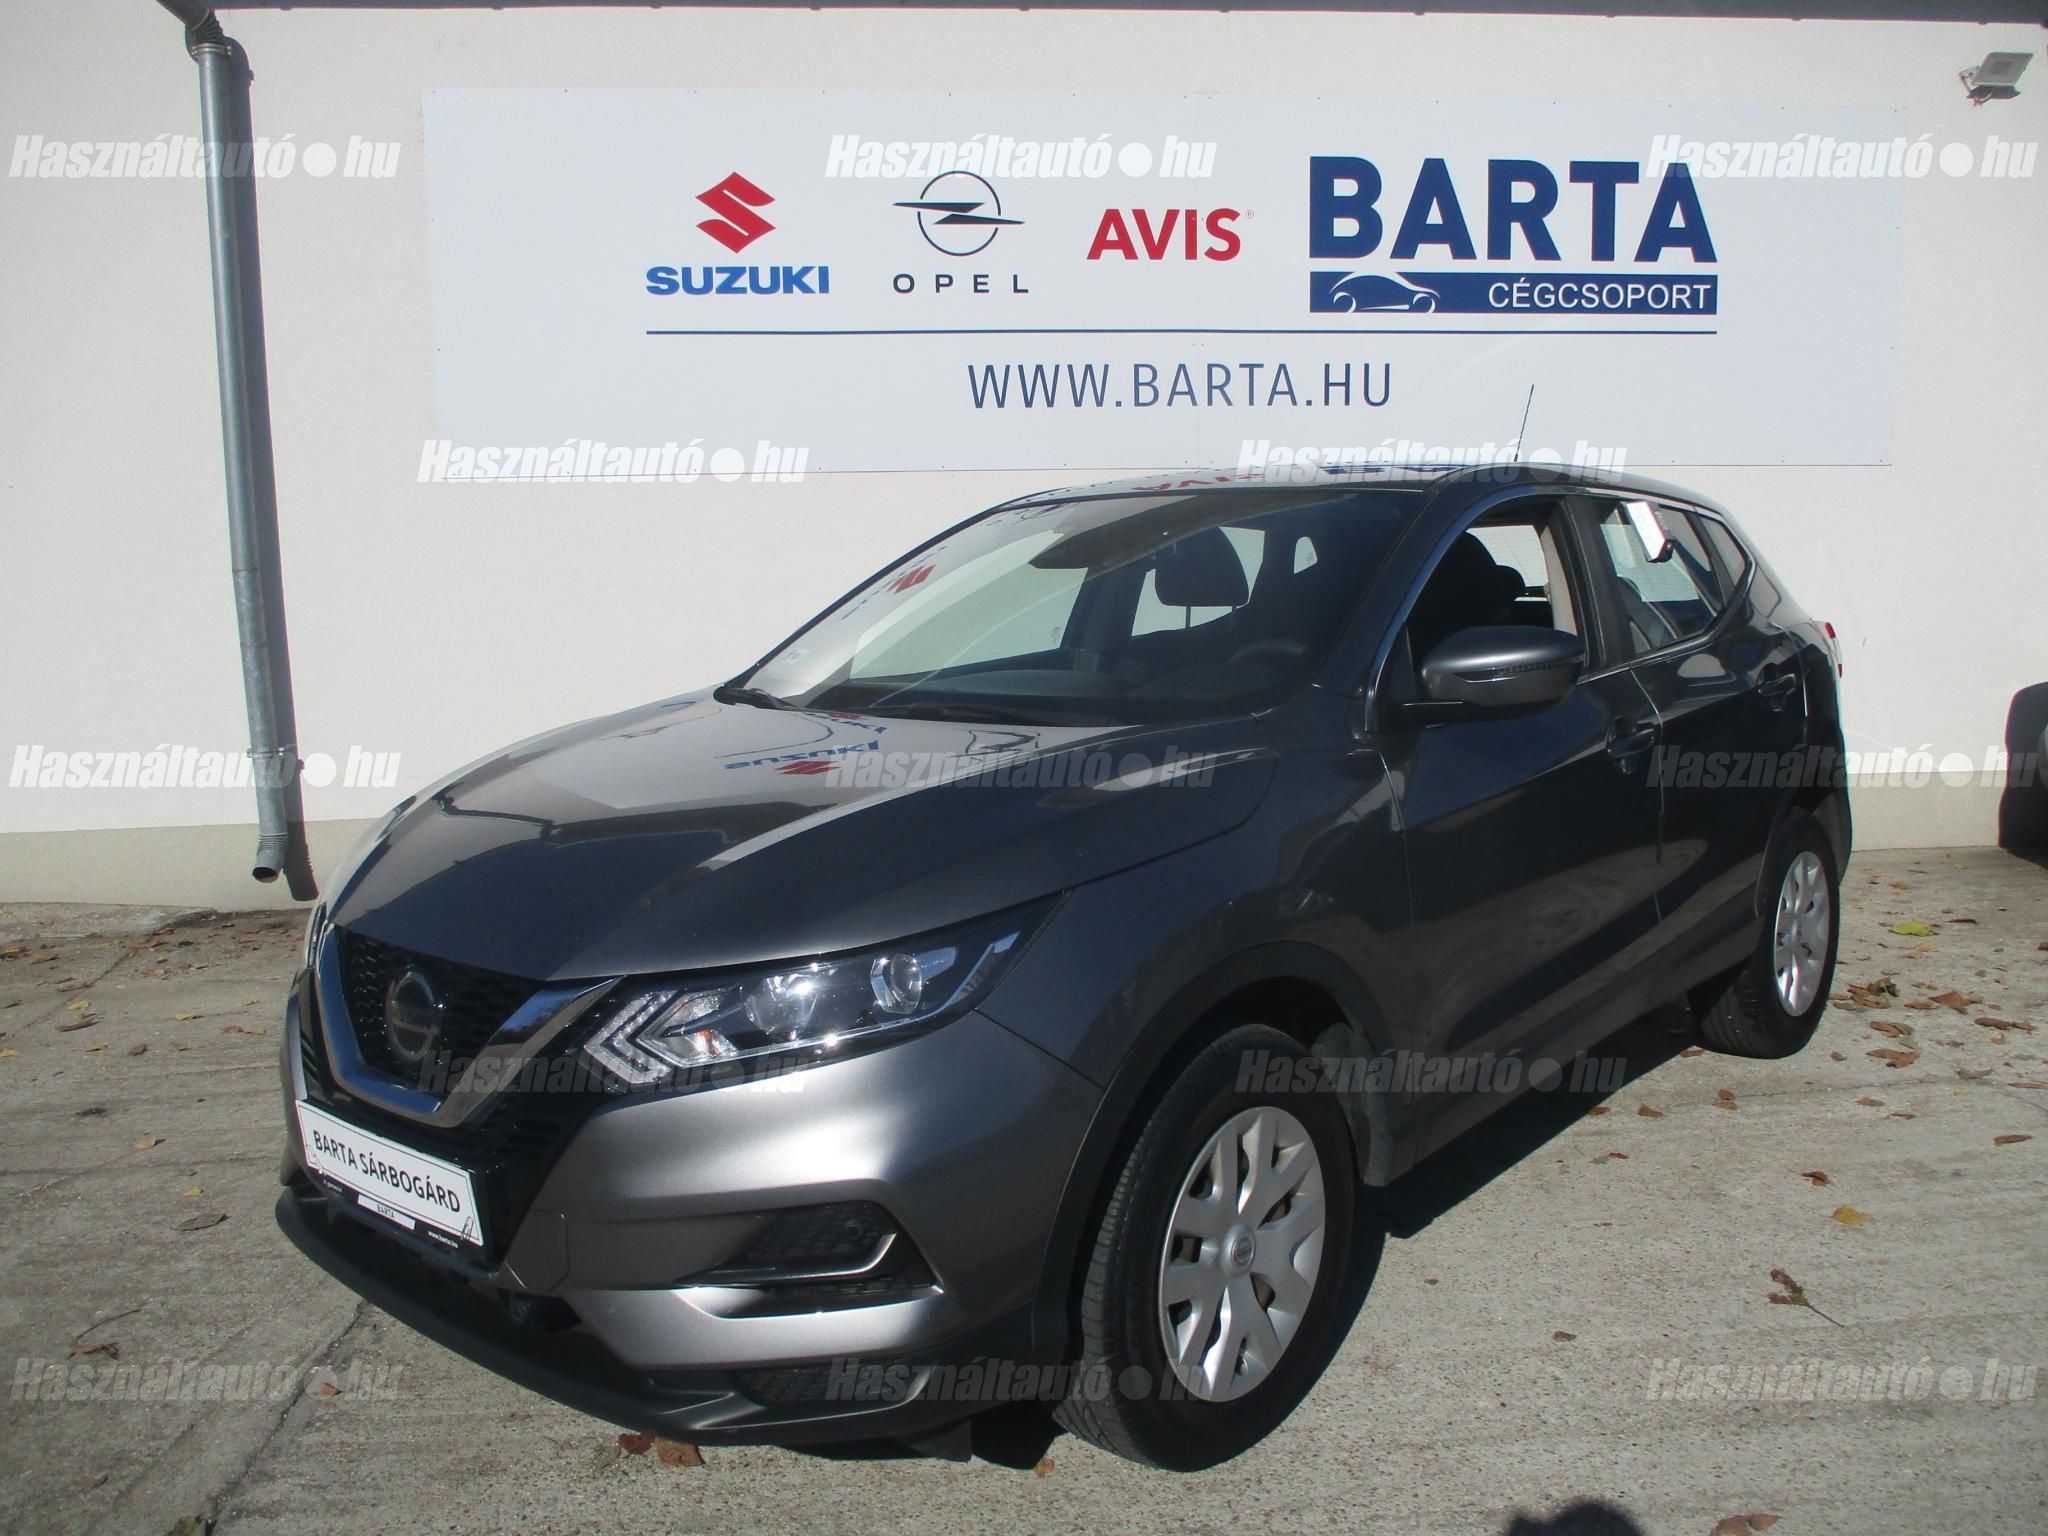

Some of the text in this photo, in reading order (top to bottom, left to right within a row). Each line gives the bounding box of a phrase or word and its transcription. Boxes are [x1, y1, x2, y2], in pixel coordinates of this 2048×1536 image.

[1310, 156, 1717, 263] BARTA
[1086, 208, 1242, 261] AVIS
[646, 265, 830, 295] SUZUKI
[893, 273, 1029, 294] OPEL
[1488, 276, 1712, 311] CÉGCSOPORT
[967, 362, 1392, 408] WWW.BARTA.HU
[313, 1129, 461, 1213] BARTA SÁRBOGÁRD
